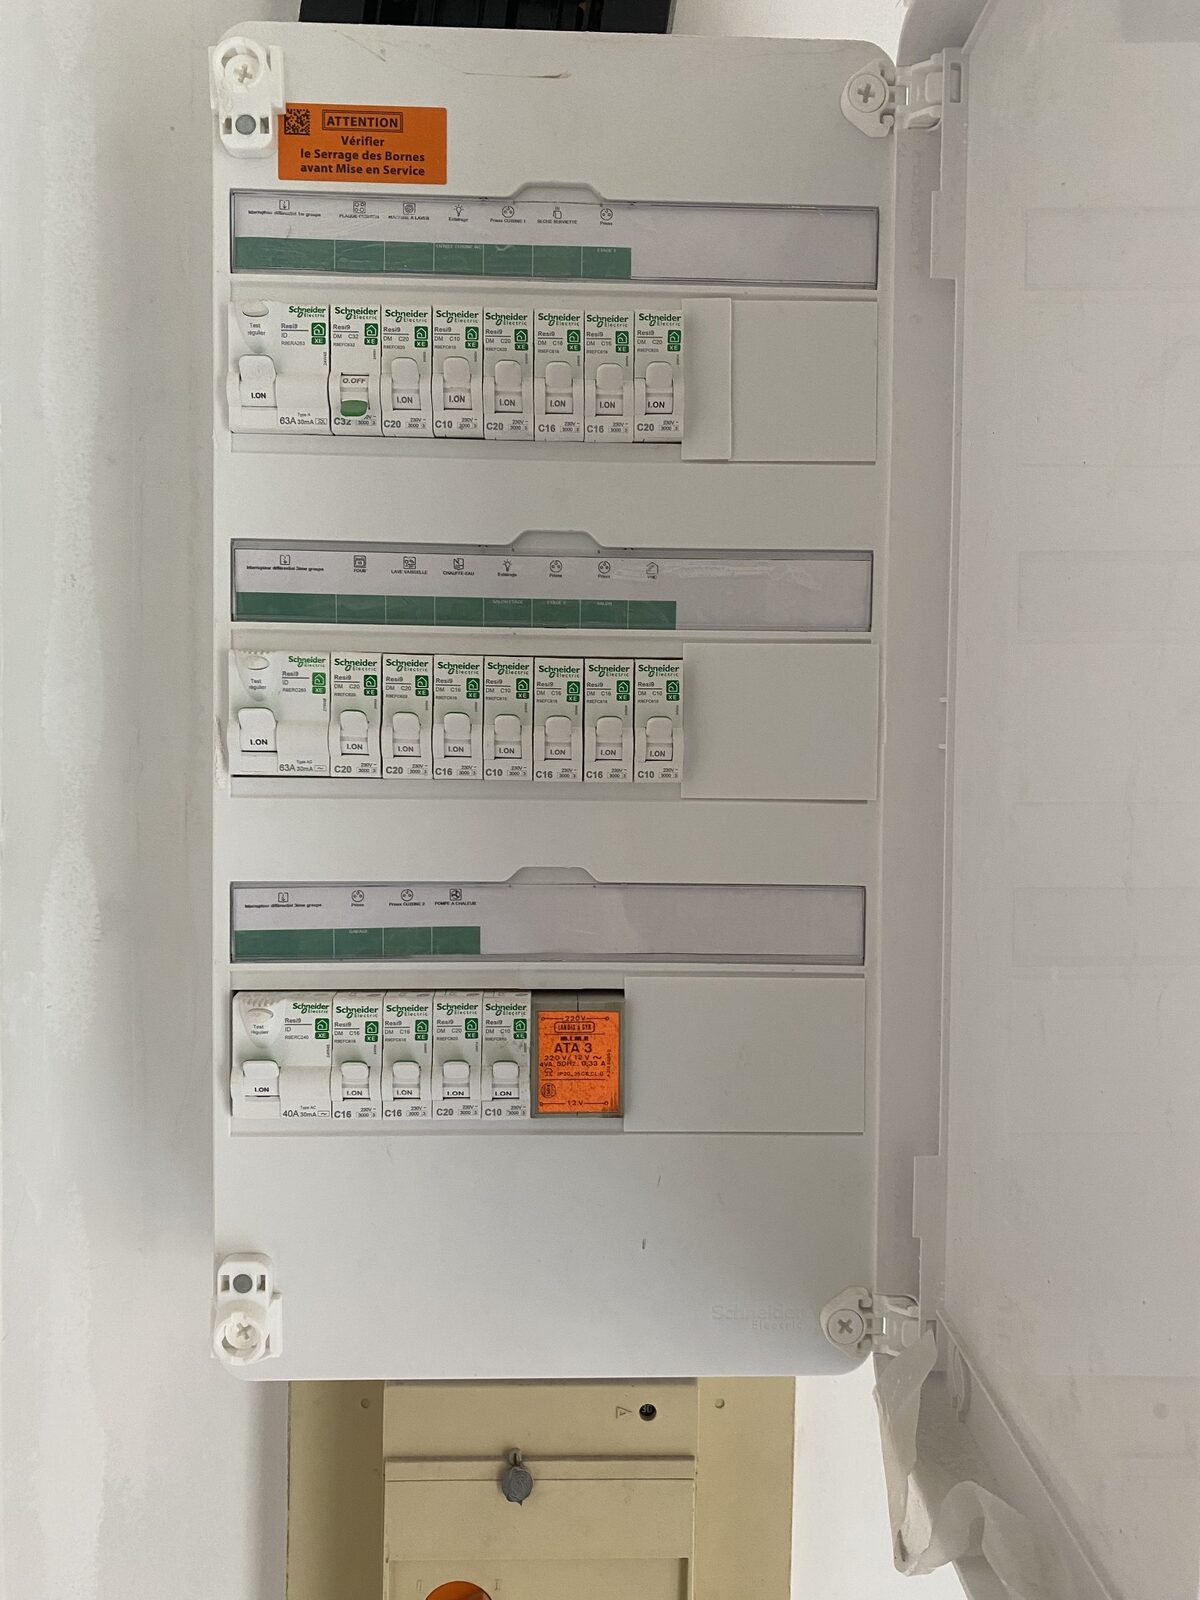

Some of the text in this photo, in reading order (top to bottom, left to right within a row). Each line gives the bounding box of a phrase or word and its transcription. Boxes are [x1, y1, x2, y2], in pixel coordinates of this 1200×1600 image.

[326, 117, 398, 128] ATTENTION
[341, 136, 384, 147] Vérifier
[300, 149, 425, 162] le Serrage des Bornes
[300, 164, 425, 176] avant Mise en Service
[288, 306, 326, 318] Schneider
[335, 306, 378, 320] Schneider
[385, 309, 428, 323] Schneider
[436, 310, 479, 324] Schneider
[485, 312, 528, 326] Schneider
[538, 313, 581, 327] Schneider
[586, 314, 629, 328] Schneider
[639, 313, 682, 327] Schneider
[396, 396, 413, 404] I.ON
[449, 395, 465, 403] I.ON
[499, 398, 516, 407] I.ON
[599, 401, 615, 409] I.ON
[279, 416, 297, 425] 63A
[383, 420, 401, 428] C20
[435, 420, 453, 429] C10
[486, 422, 504, 431] C20
[538, 424, 556, 433] C16
[586, 425, 604, 433] C16
[637, 423, 654, 432] C20
[288, 656, 326, 668] Schneider
[334, 658, 378, 672] Schneider
[386, 658, 429, 672] Schneider
[437, 661, 480, 675] Schneider
[487, 662, 530, 675] Schneider
[538, 665, 581, 679] Schneider
[588, 664, 630, 678] Schneider
[638, 664, 680, 678] Schneider
[279, 764, 296, 772] 63A
[334, 765, 352, 773] C20
[386, 766, 403, 774] C20
[435, 767, 453, 776] C16
[485, 768, 503, 776] C10
[535, 770, 553, 779] C16
[586, 771, 603, 779] C16
[637, 770, 655, 779] C10
[292, 1002, 330, 1014] Schneider
[336, 1006, 379, 1019] Schneider
[386, 1004, 429, 1018] Schneider
[436, 1003, 479, 1016] Schneider
[485, 1003, 527, 1016] Schneider
[554, 1043, 592, 1053] ATA 3
[334, 1110, 352, 1118] C16
[384, 1109, 402, 1117] C16
[436, 1108, 454, 1116] C20
[485, 1108, 502, 1116] C10
